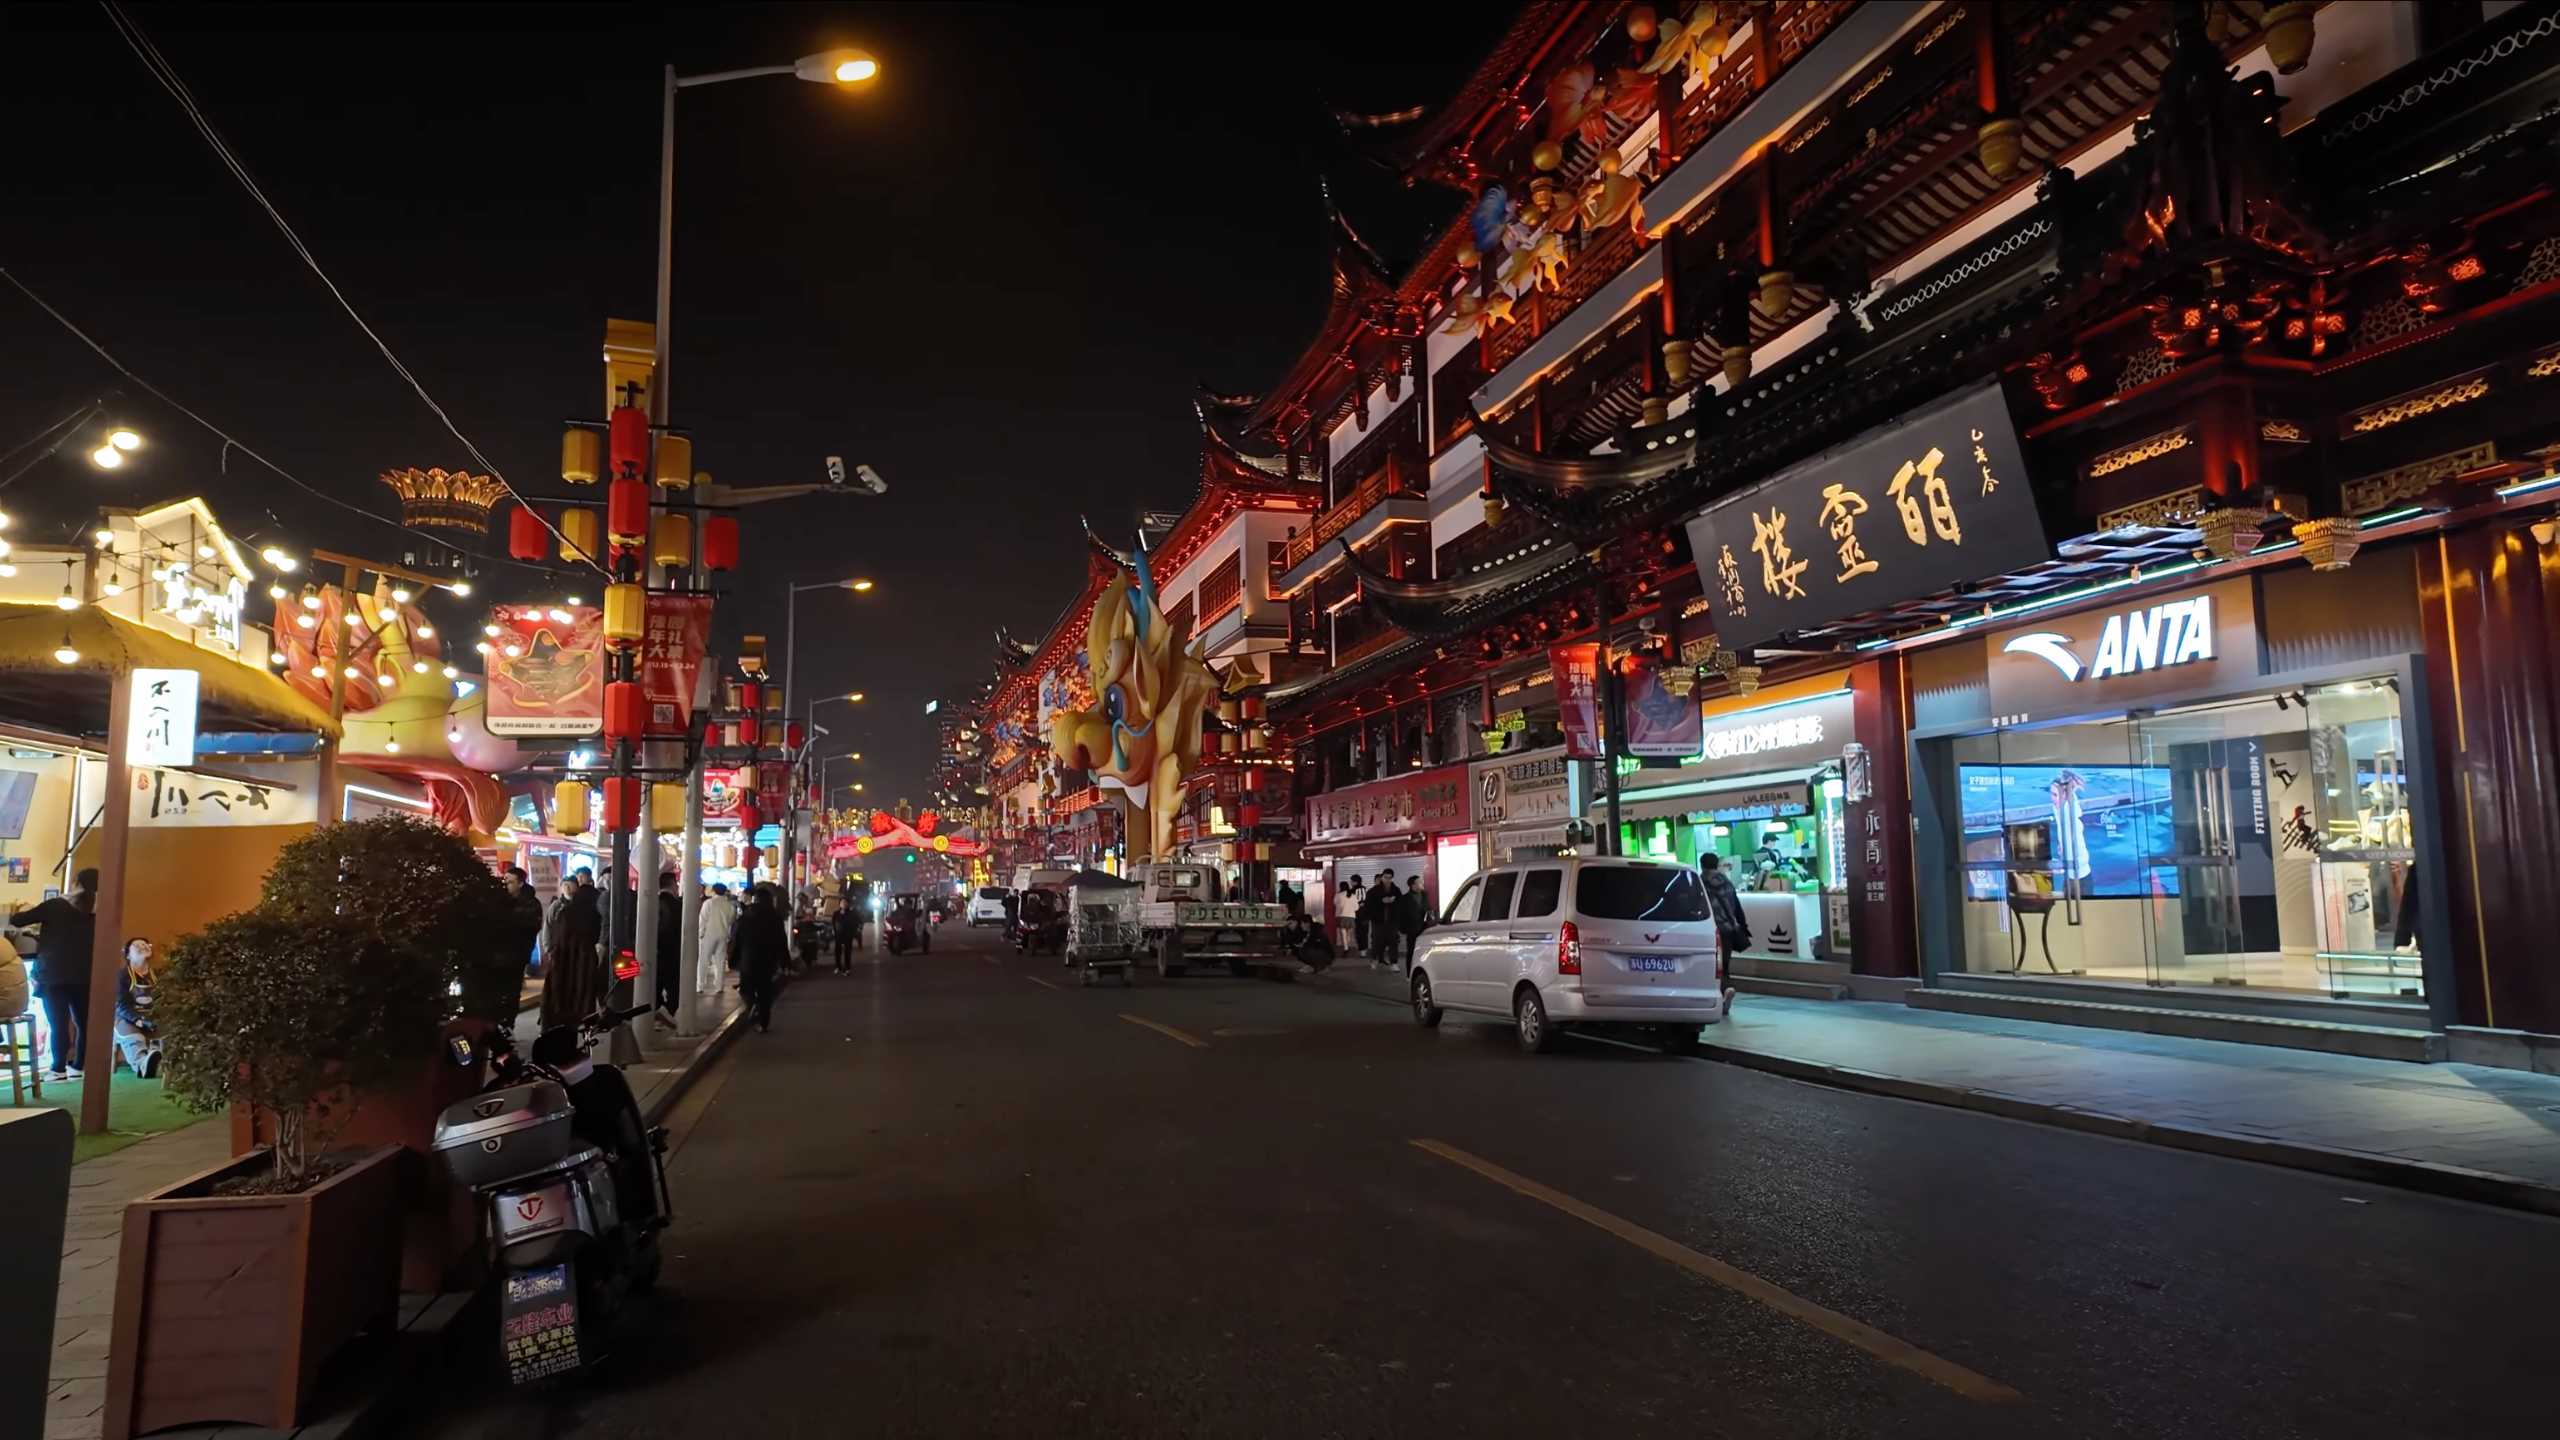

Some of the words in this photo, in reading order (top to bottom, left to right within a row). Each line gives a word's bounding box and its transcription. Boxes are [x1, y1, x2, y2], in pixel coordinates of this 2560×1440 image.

[2091, 594, 2216, 680] ANTA
[2248, 756, 2262, 786] ROOM
[2251, 788, 2266, 835] FITTING
